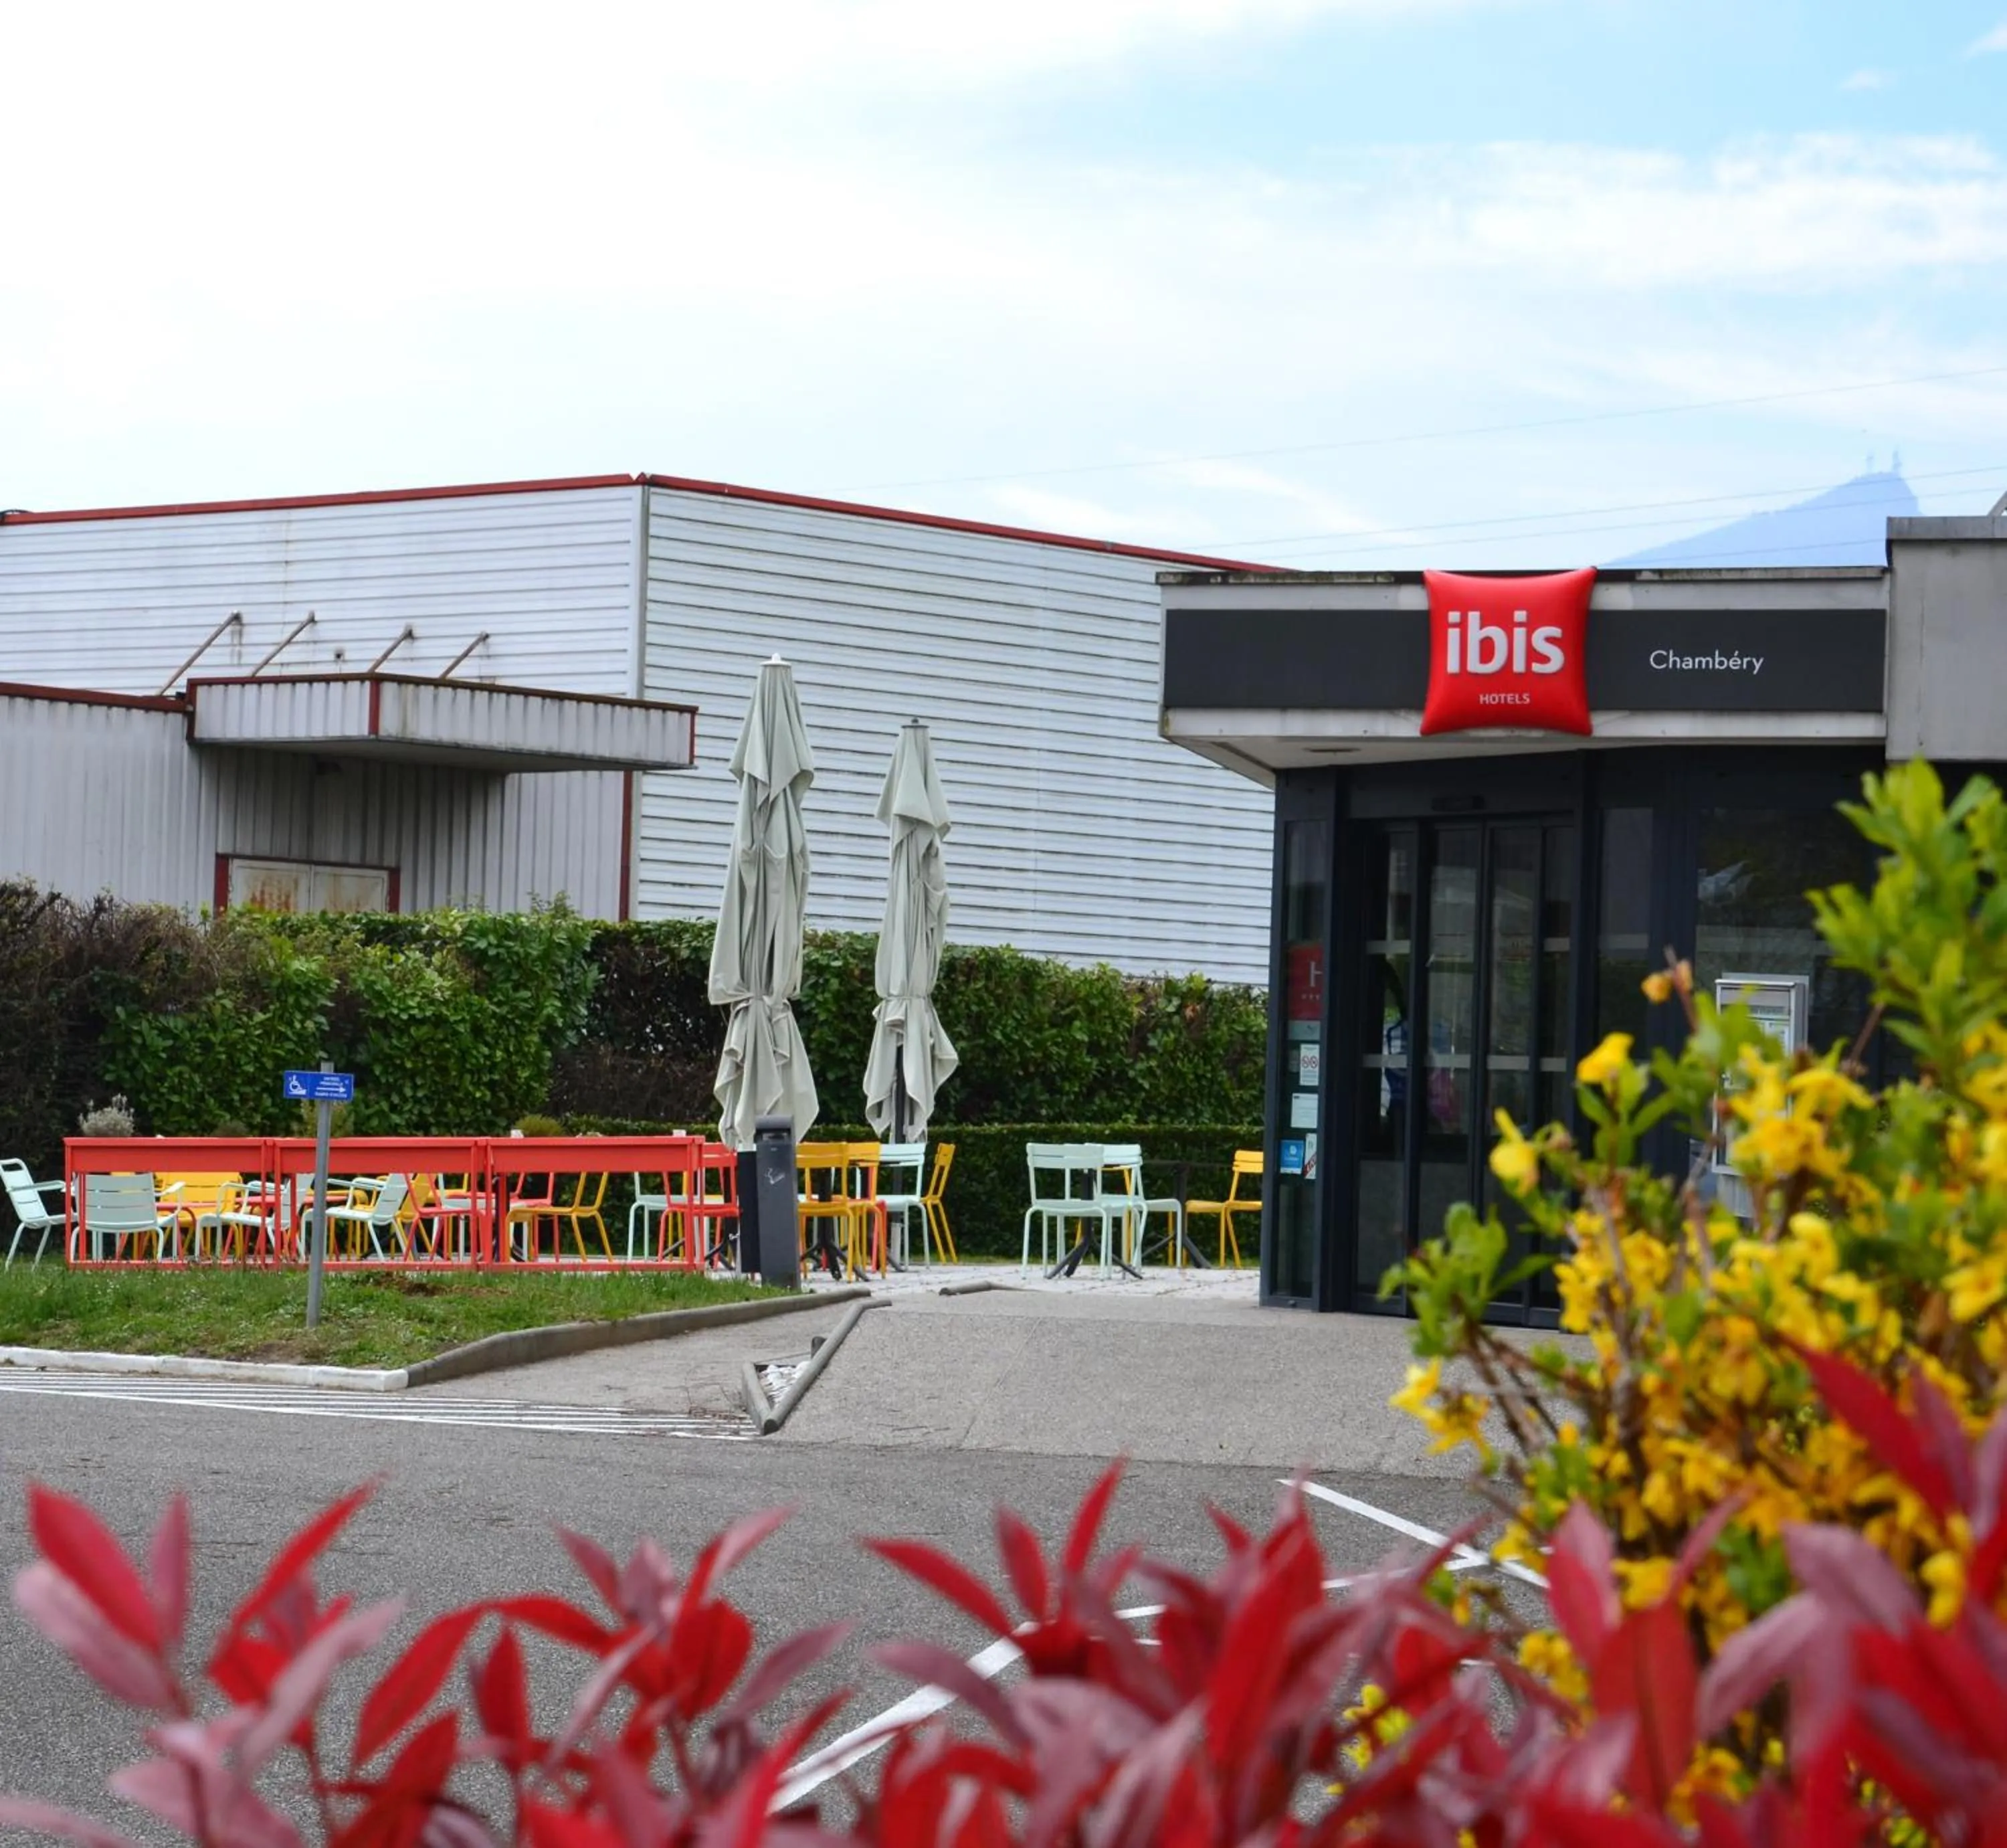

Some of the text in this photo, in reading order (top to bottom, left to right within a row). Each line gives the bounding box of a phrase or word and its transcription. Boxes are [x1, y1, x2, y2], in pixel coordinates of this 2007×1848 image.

[1446, 610, 1565, 674] ibis
[1649, 650, 1764, 674] Chambéry
[1479, 693, 1531, 705] HOTELS
